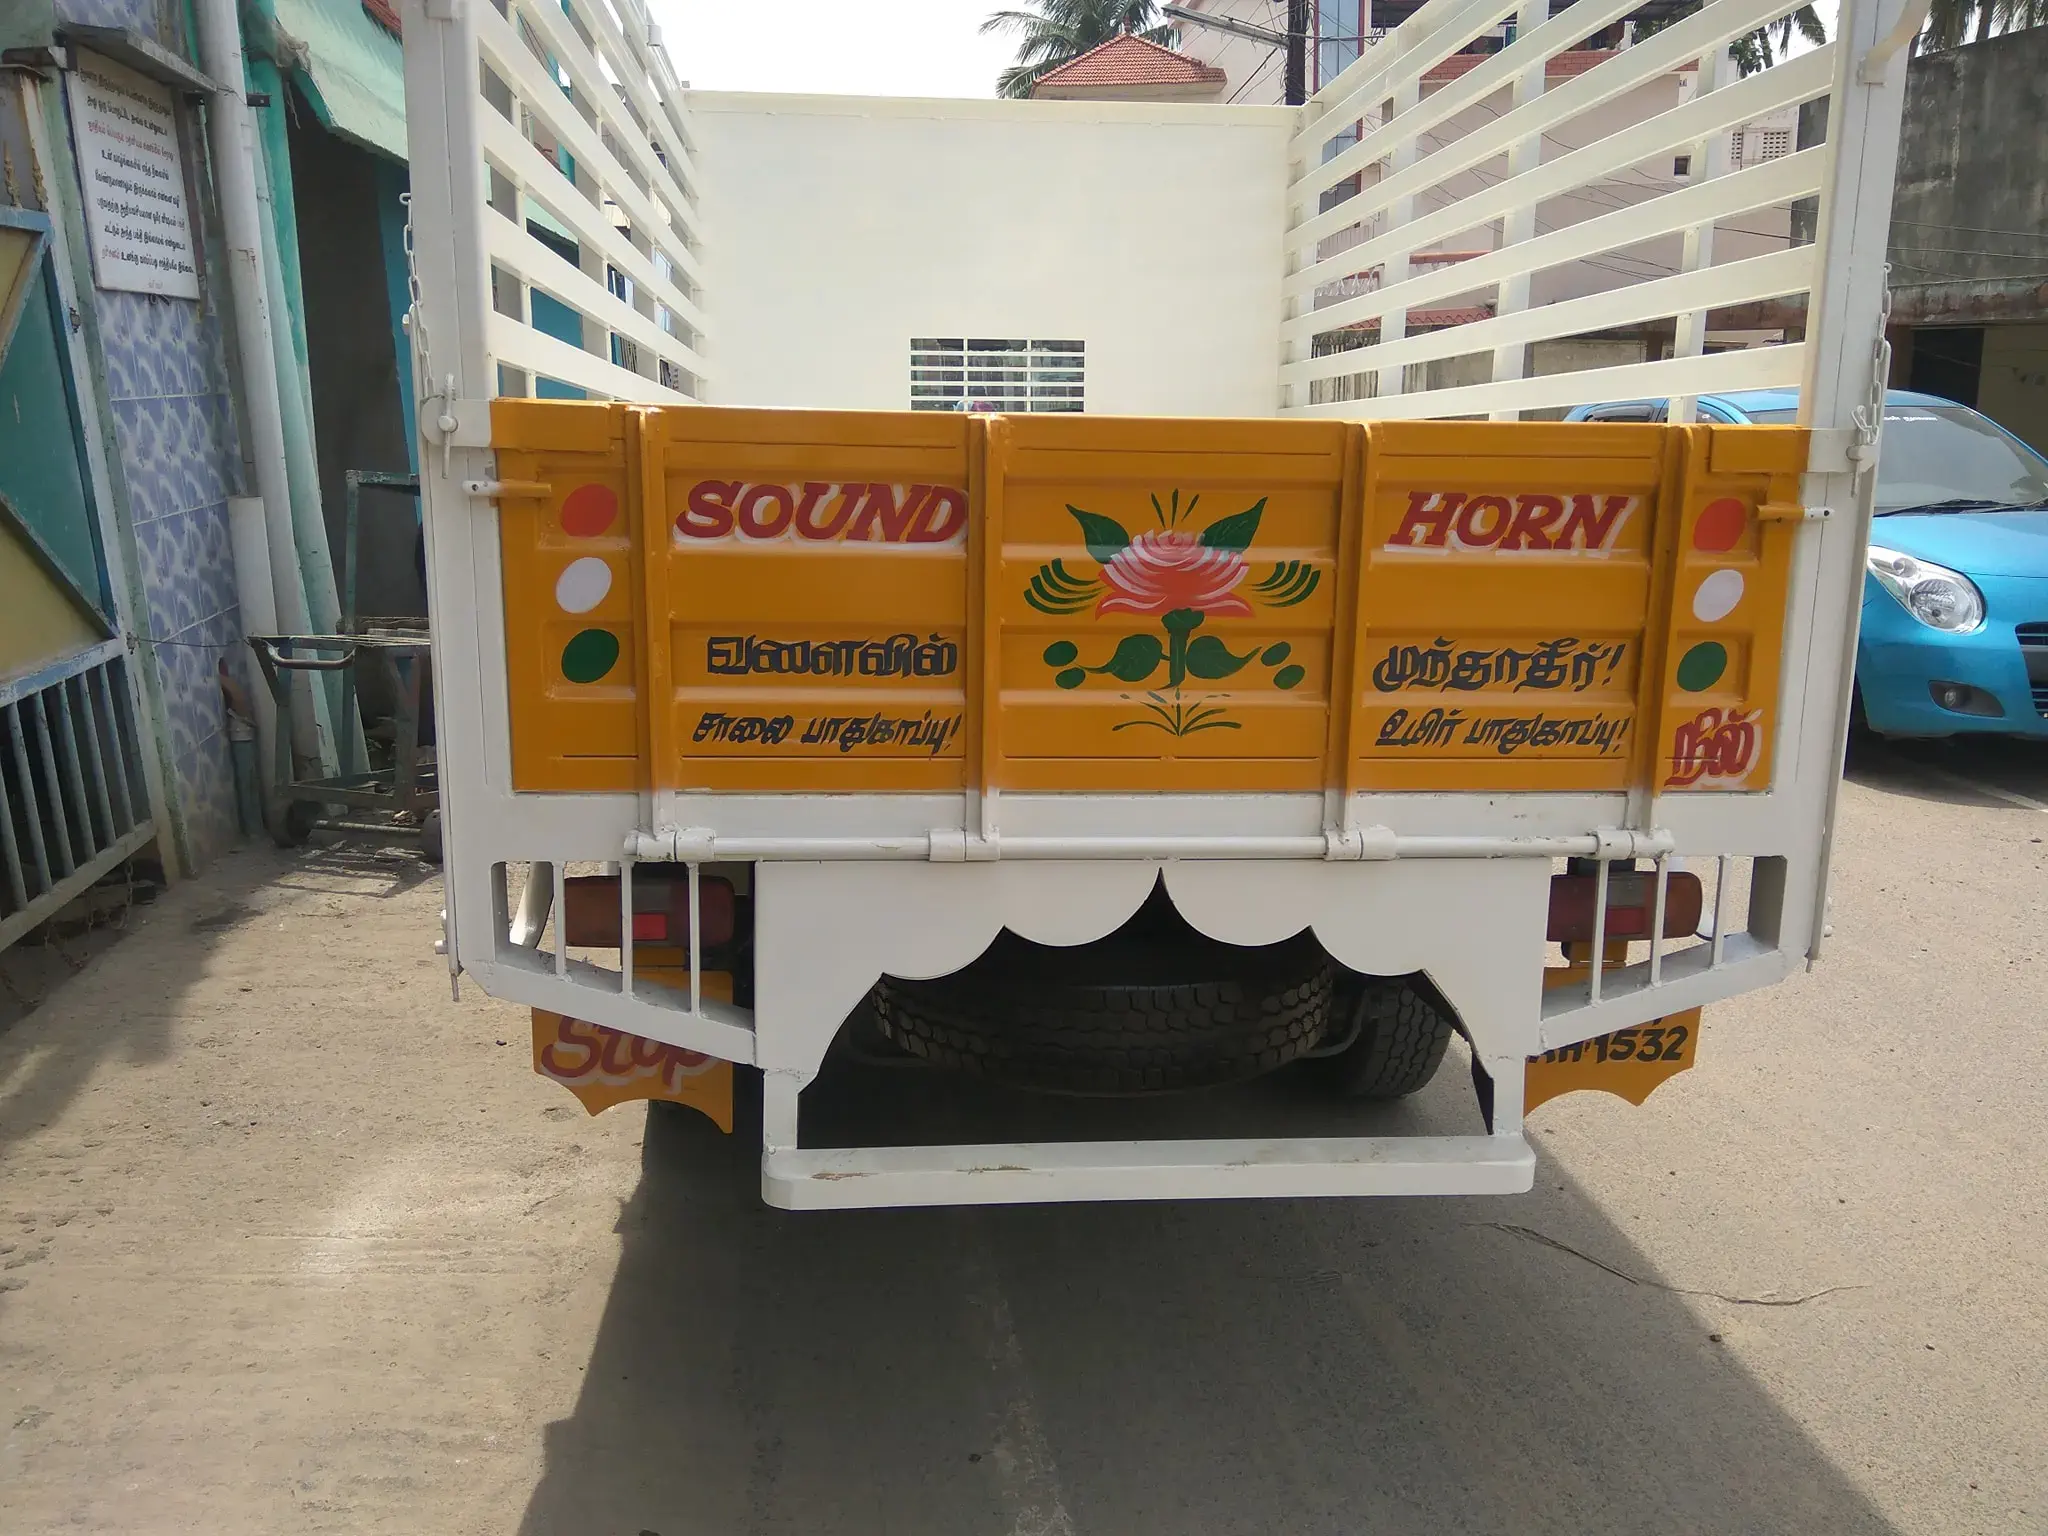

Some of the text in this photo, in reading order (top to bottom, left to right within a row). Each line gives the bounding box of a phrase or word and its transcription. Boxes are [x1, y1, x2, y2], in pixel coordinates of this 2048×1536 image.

[673, 479, 969, 548] SOUND
[1386, 490, 1634, 555] HORN
[706, 632, 959, 679] வளைவில்
[691, 711, 794, 744] சாலை
[1374, 707, 1468, 747] உயிர்
[1664, 706, 1760, 787] நில்
